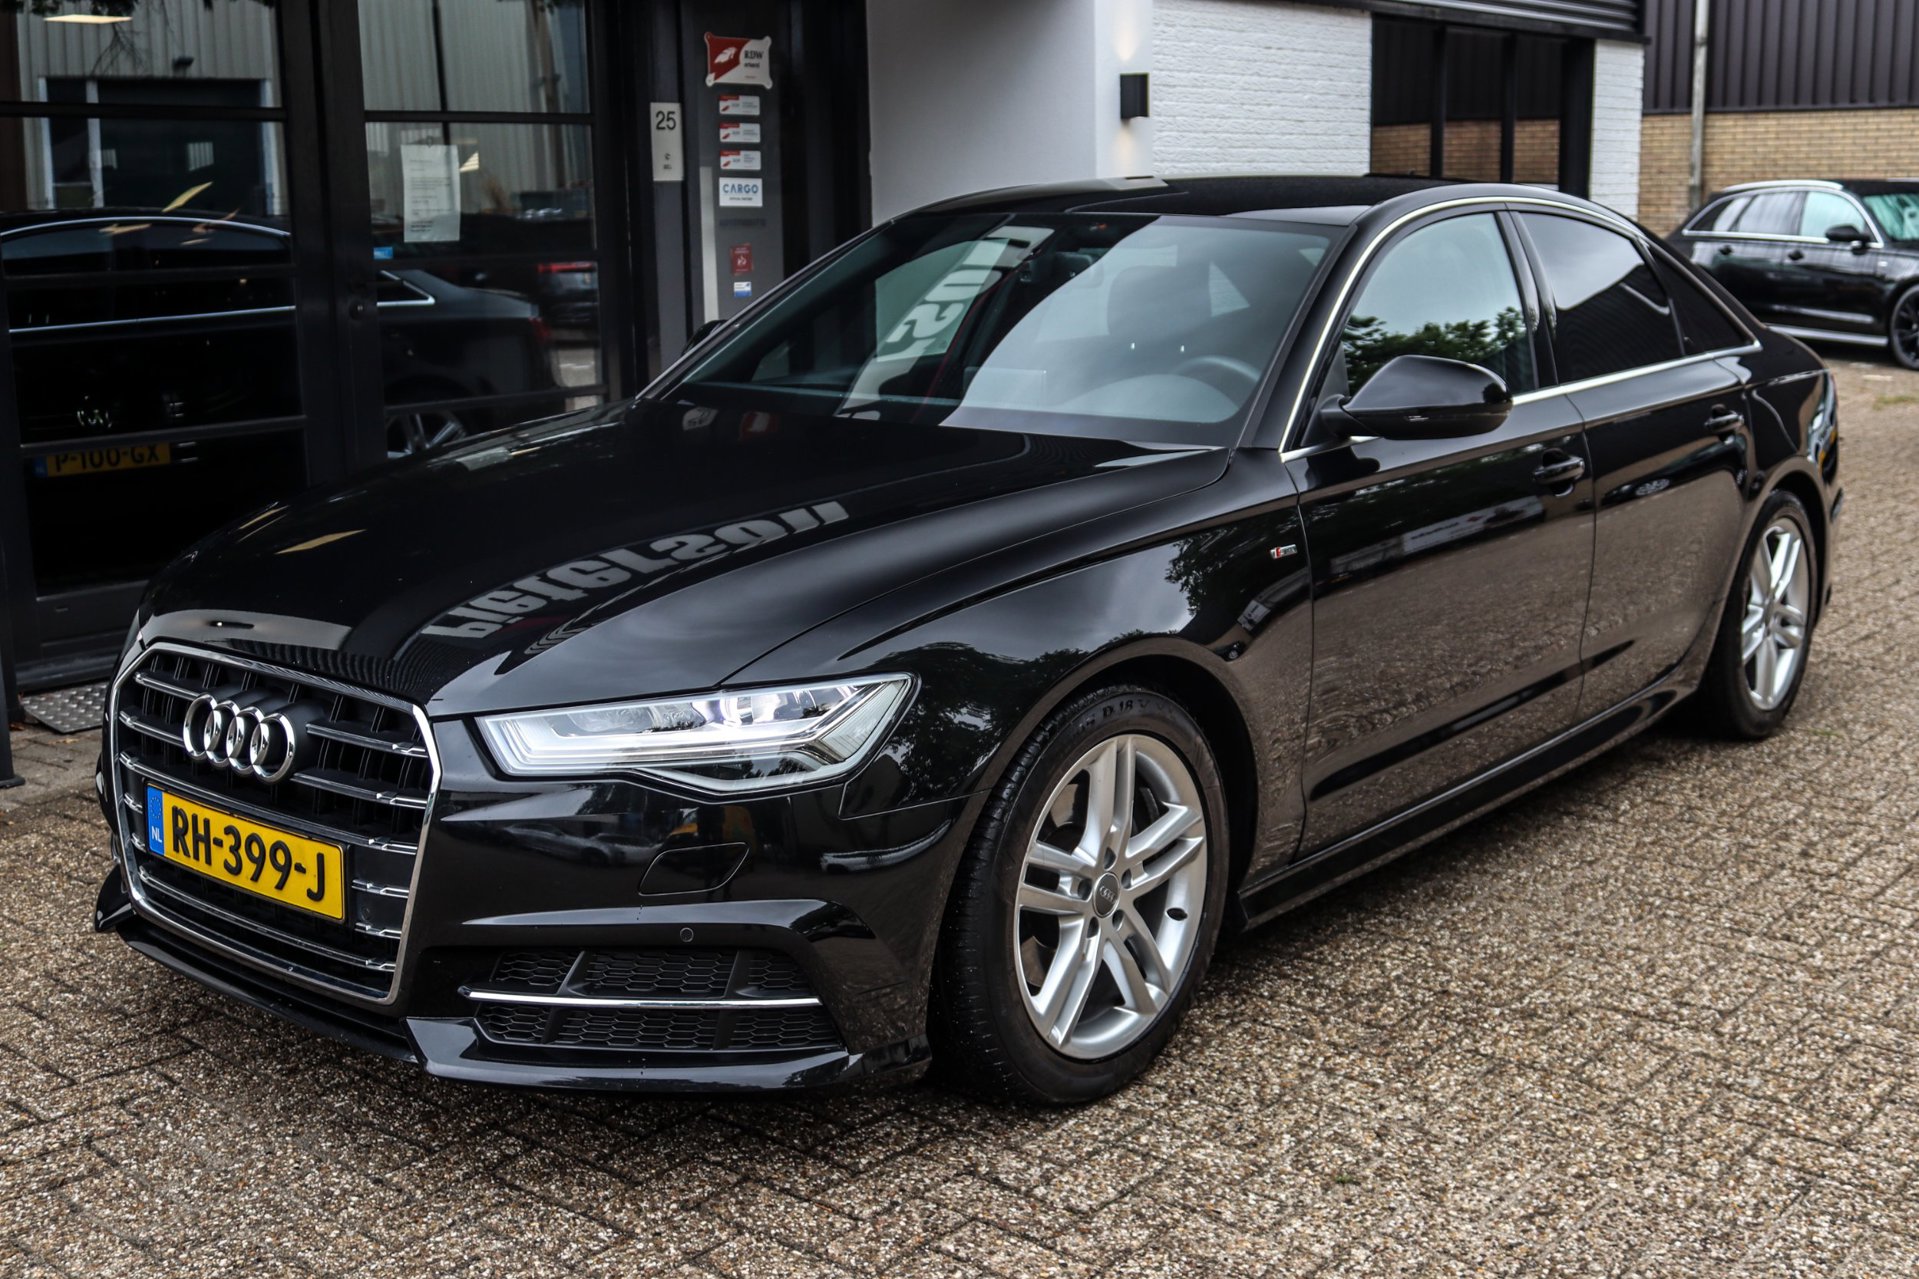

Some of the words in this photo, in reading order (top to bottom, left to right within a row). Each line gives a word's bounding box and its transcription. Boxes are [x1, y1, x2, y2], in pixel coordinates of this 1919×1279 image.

[655, 111, 677, 131] 25
[722, 183, 759, 195] CARGO
[55, 447, 160, 473] P-100-GX
[151, 825, 163, 844] NL
[171, 805, 326, 901] RH-399-J
